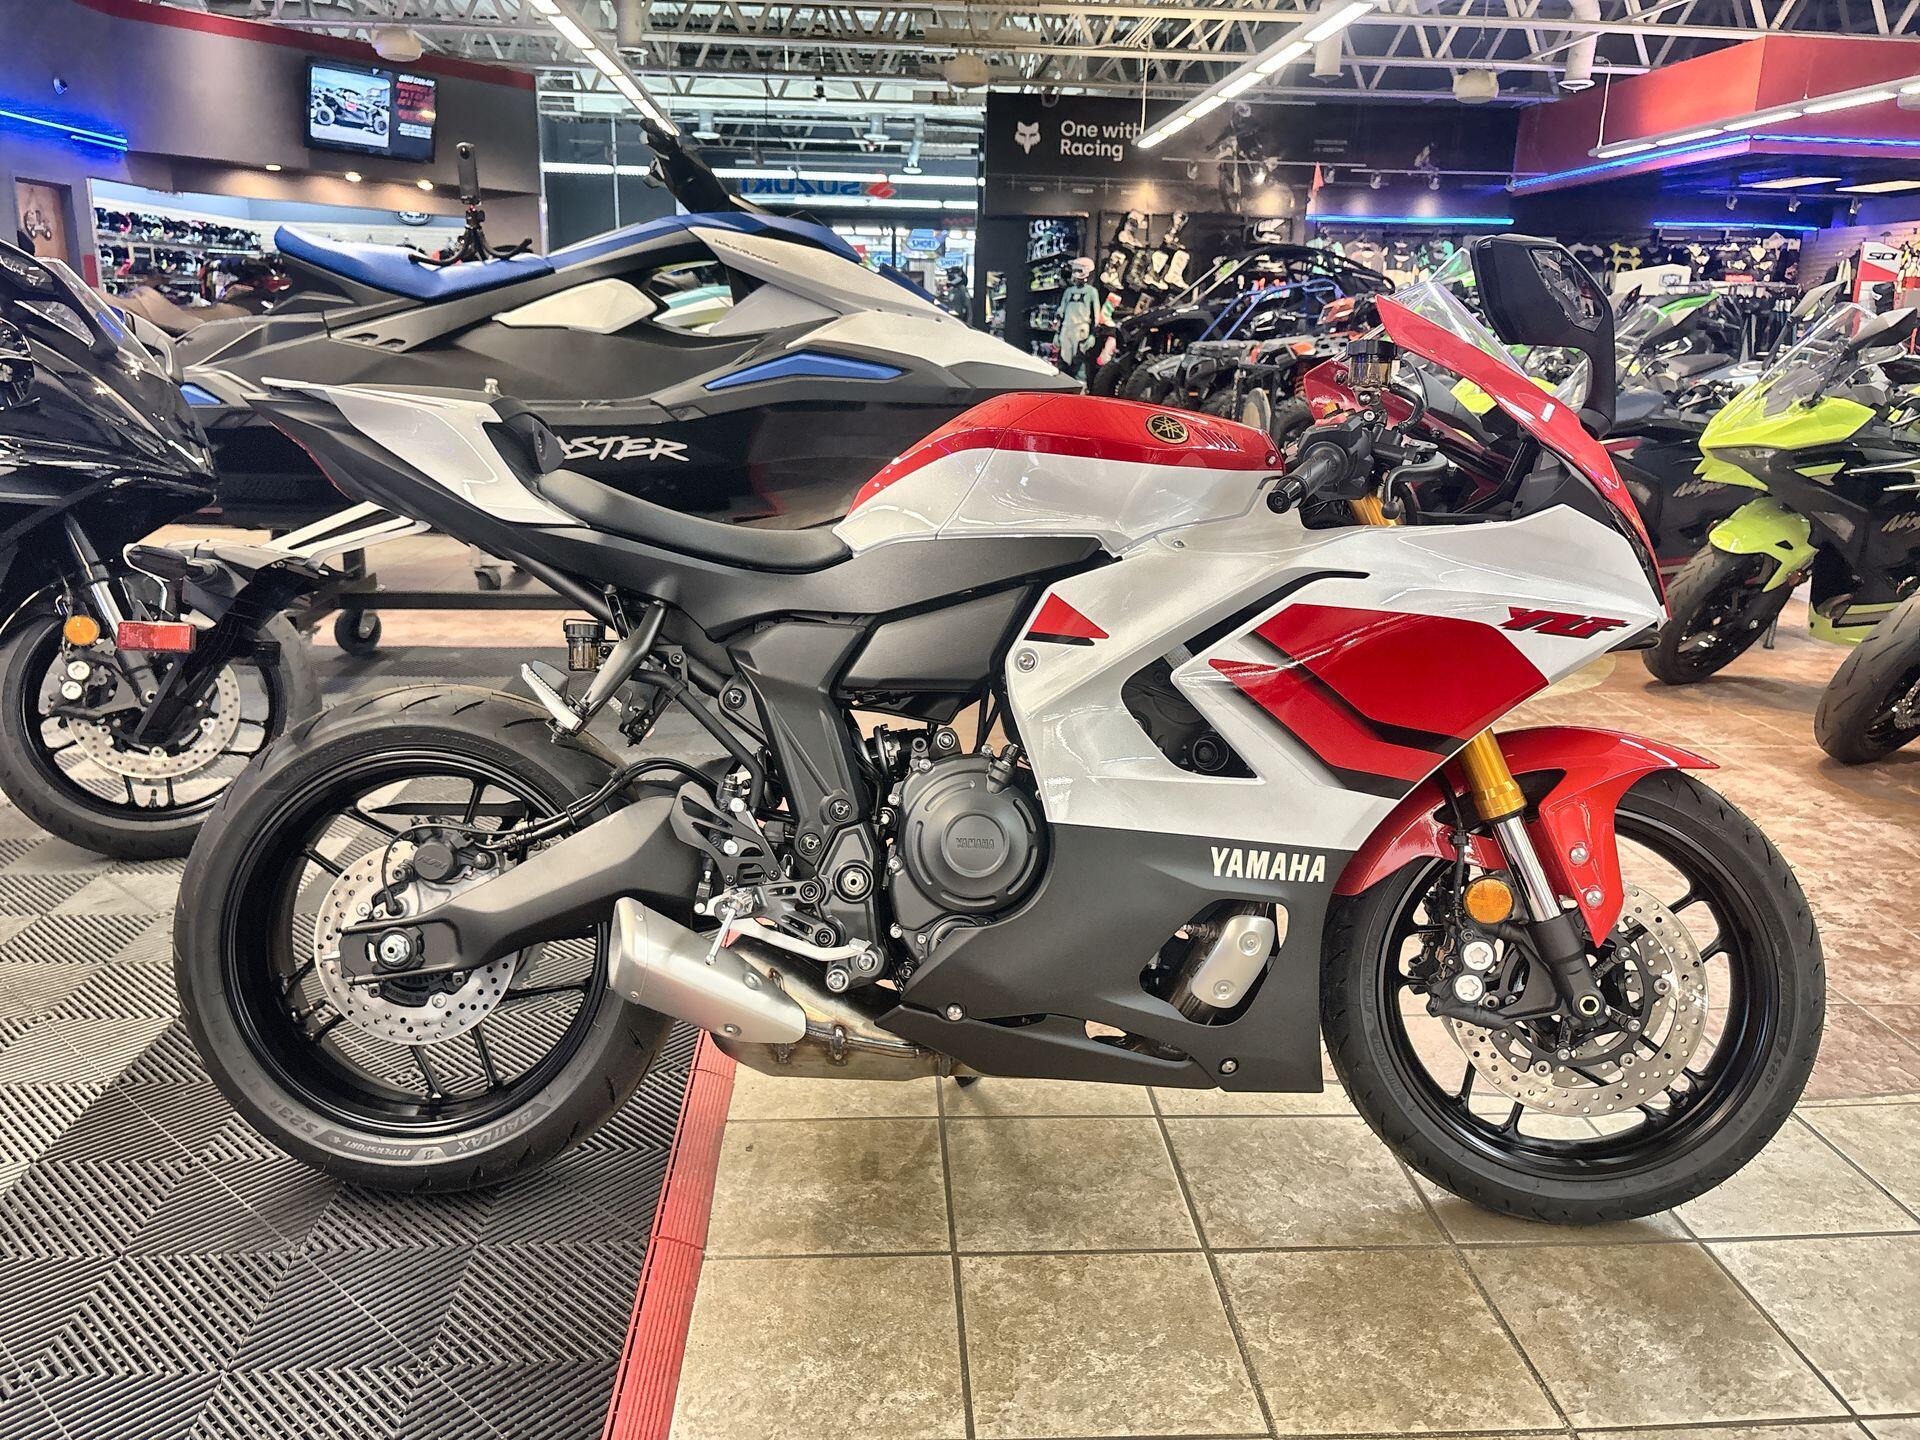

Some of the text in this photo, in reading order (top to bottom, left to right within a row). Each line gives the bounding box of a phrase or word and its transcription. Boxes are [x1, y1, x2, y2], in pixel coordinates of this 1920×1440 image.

[1060, 119, 1099, 138] One
[1060, 138, 1124, 162] Racing
[955, 837, 995, 849] YAMAHA
[1210, 846, 1326, 883] YAMAHA
